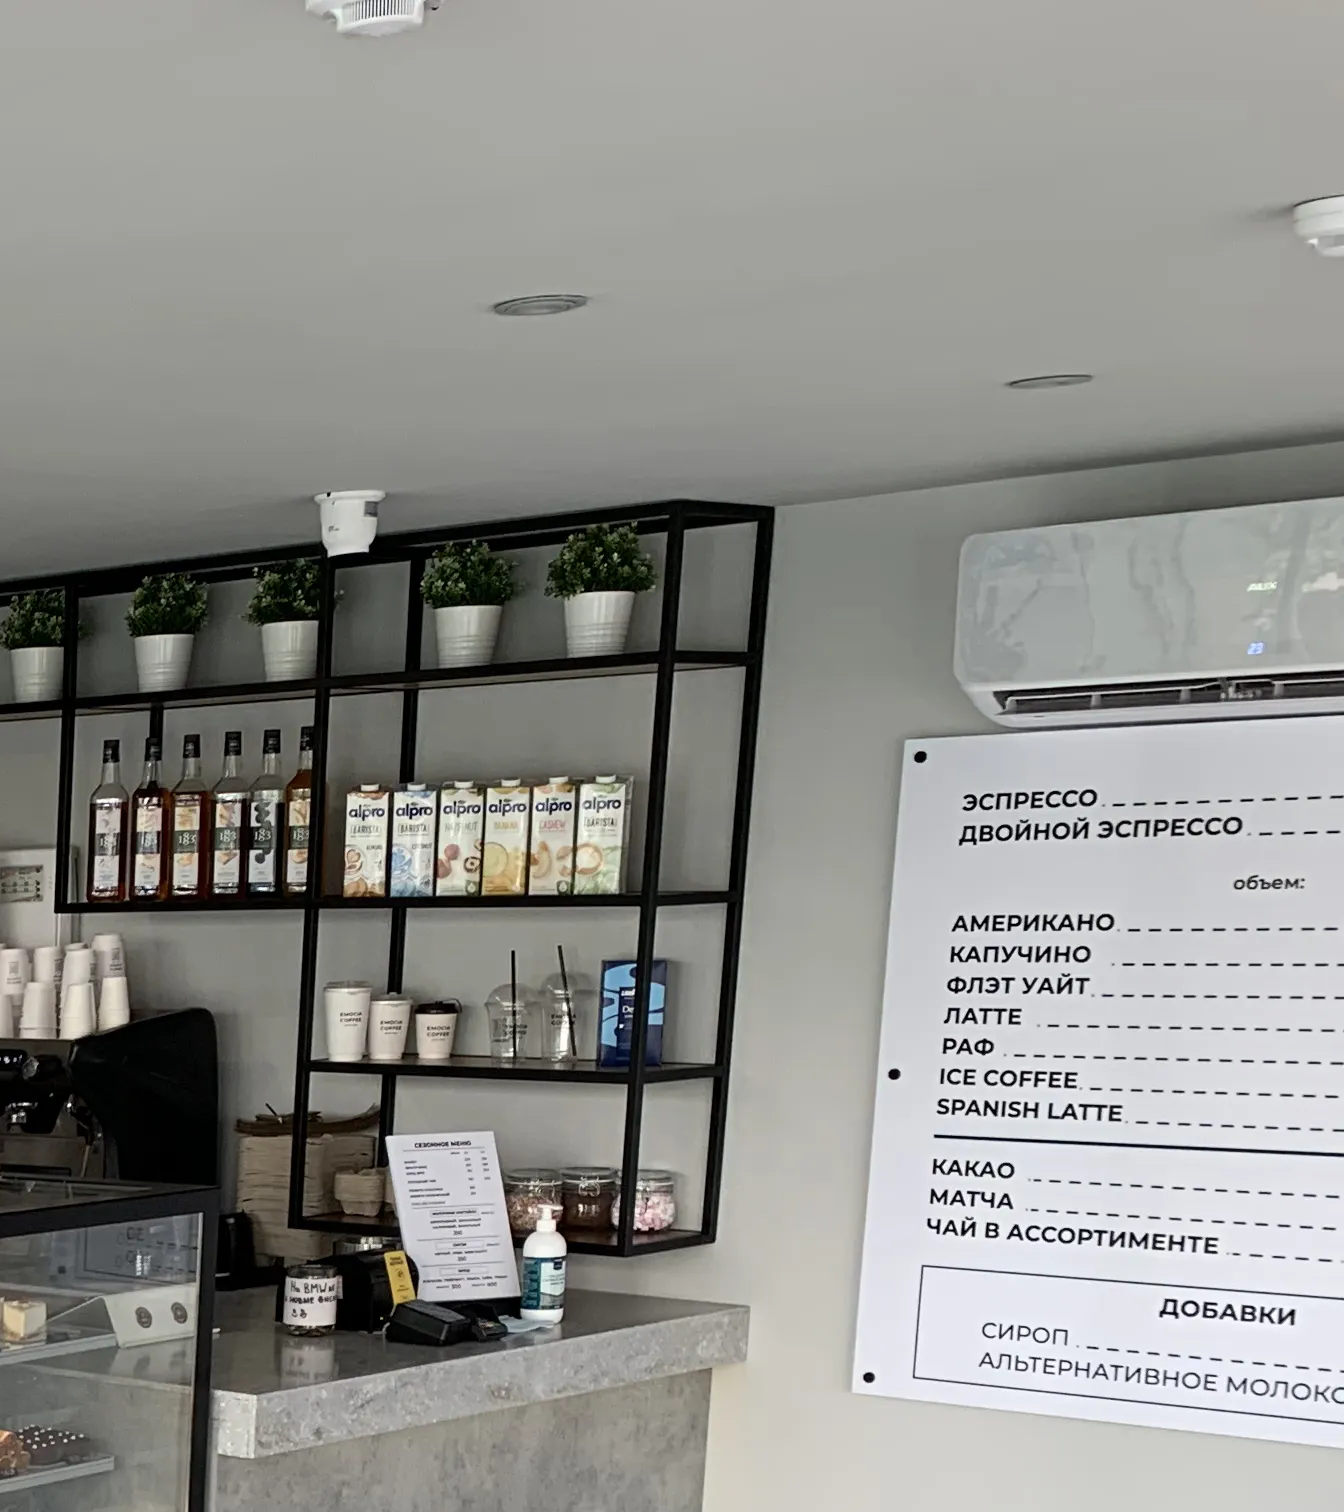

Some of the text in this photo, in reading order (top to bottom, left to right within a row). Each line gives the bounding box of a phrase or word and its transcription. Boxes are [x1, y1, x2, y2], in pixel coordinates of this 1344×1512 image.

[442, 801, 482, 818] alpro
[488, 799, 527, 817] alpro
[535, 798, 573, 815] alpro
[582, 796, 622, 813] alpro
[962, 788, 1099, 812] ЭСПРЕССО
[348, 804, 385, 821] alpro
[395, 802, 433, 820] alpro
[958, 816, 1243, 846] ДВОЙНОЙ ЭСПРЕССО
[1233, 875, 1306, 893] объем:
[952, 913, 1115, 933] АМЕРИКАНО
[949, 945, 1092, 964] КАПУЧИНО
[947, 973, 1090, 996] ФЛЭТ УАЙТ
[943, 1007, 1022, 1026] ЛАТТЕ
[941, 1037, 995, 1056] РАФ
[939, 1067, 1079, 1090] ICE COFFEE
[936, 1098, 1123, 1123] SPANISH LATTE
[414, 1141, 450, 1149] СЕЗОННОЕ
[931, 1158, 1015, 1180] КАКАО
[929, 1188, 1014, 1210] МАТЧА
[926, 1215, 1219, 1255] ЧАЙ В АССОРТИМЕНТЕ
[303, 1282, 328, 1294] BMW
[1158, 1298, 1297, 1326] ДОБАВКИ
[981, 1321, 1069, 1347] СИРОП
[978, 1351, 1218, 1393] АЛЬТЕРНАТИВНОЕ
